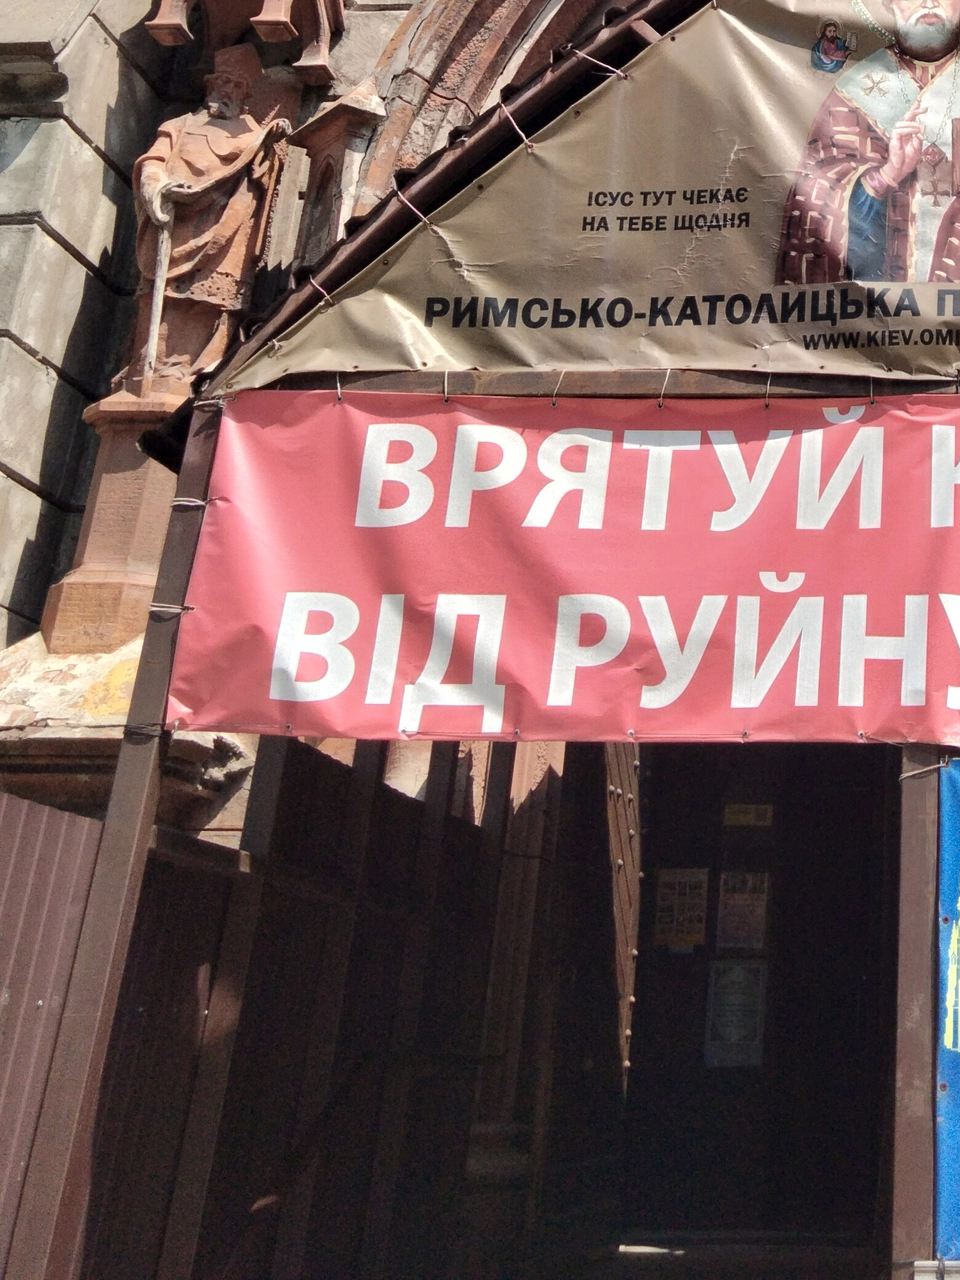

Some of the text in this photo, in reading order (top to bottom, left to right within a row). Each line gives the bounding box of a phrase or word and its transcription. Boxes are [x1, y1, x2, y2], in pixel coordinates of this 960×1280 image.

[587, 187, 749, 206] ІСУС ТУТ ЧЕКАЄ
[581, 212, 750, 233] НА ТЕБЕ ЩОДНЯ
[424, 286, 921, 330] РИМСЬКО-КАТОЛИЦЬКА
[355, 408, 884, 532] ВРЯТУЙ
[269, 592, 506, 733] ВІД
